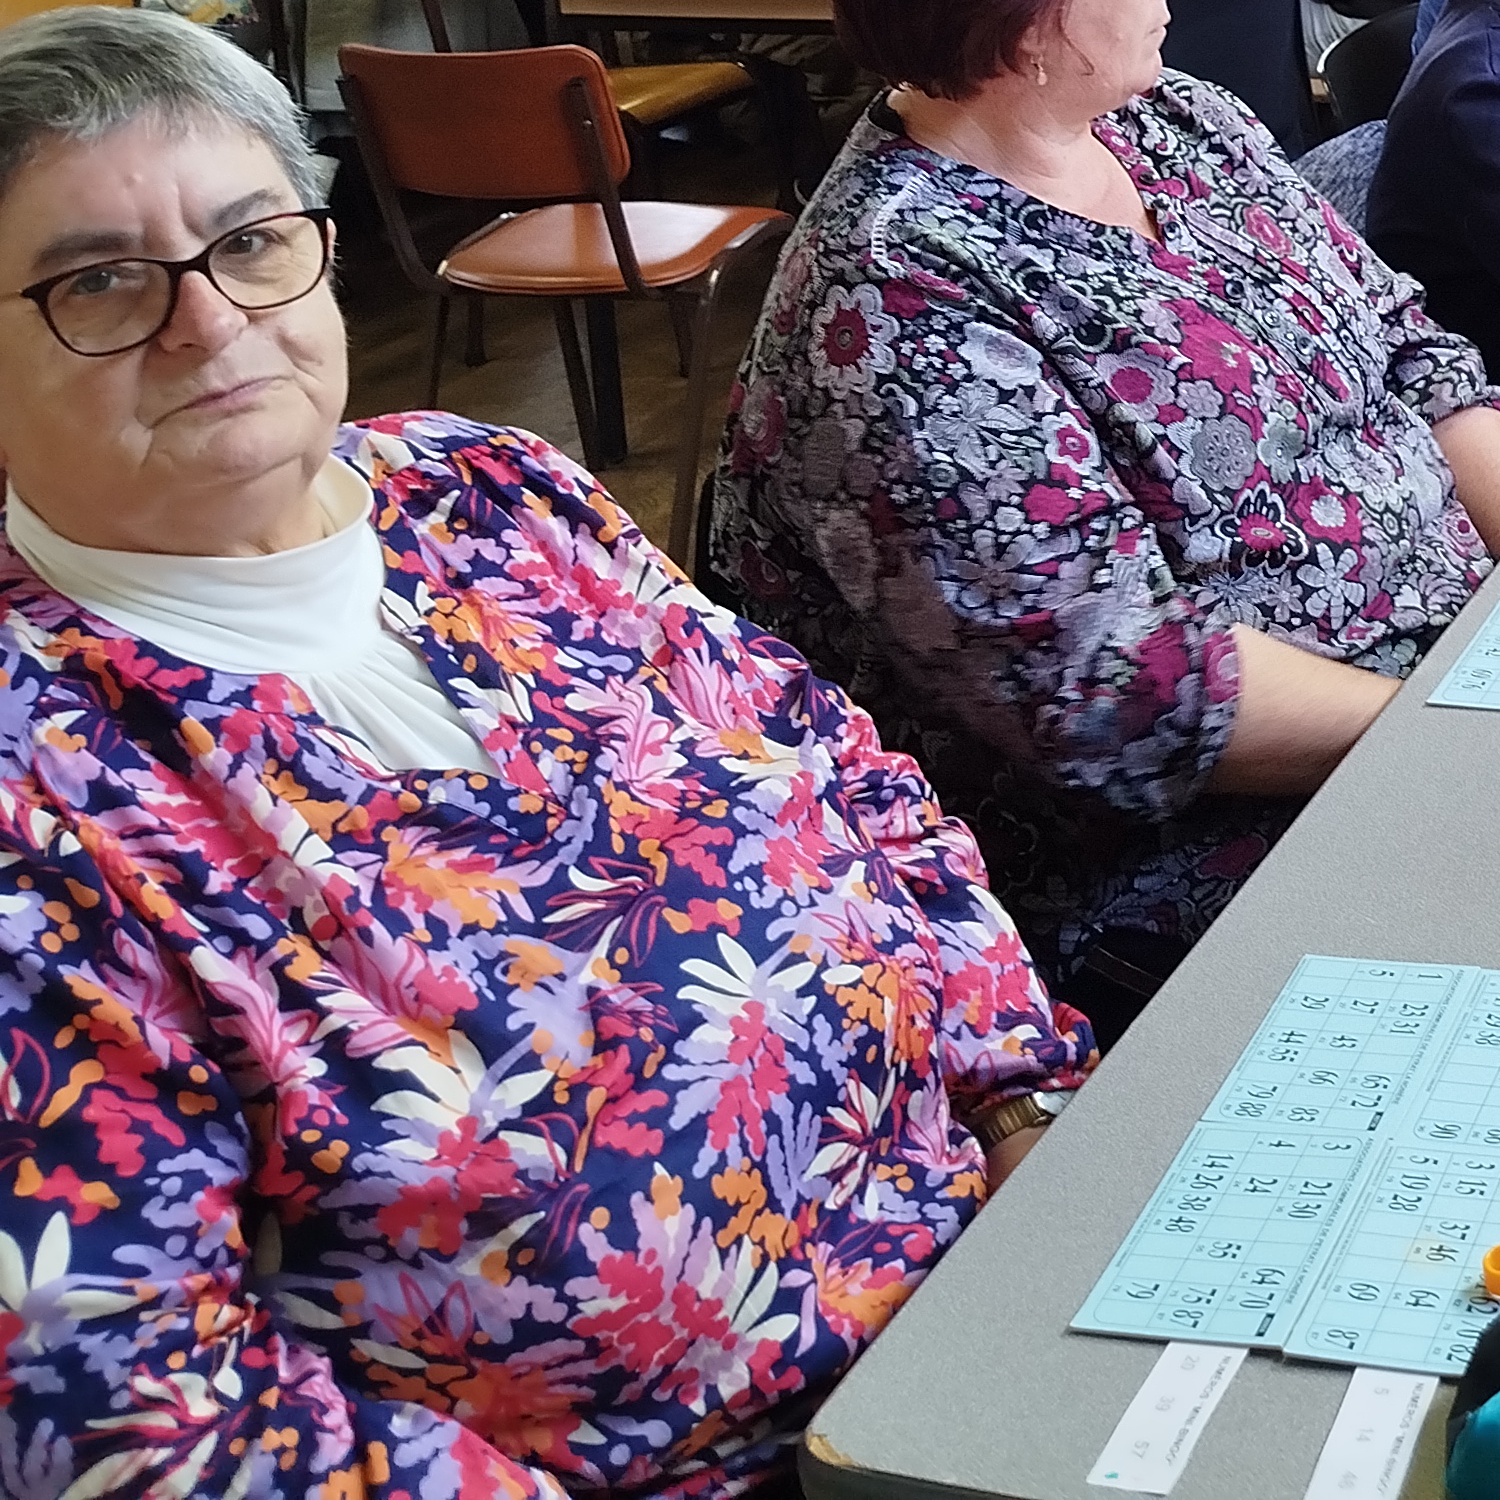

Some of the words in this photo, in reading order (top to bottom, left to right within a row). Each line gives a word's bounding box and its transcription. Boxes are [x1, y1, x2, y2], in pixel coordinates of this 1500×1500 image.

[1301, 995, 1330, 1010] 29
[1349, 999, 1380, 1013] 27
[1398, 1003, 1430, 1017] 23
[1388, 1022, 1421, 1035] 31
[1277, 1030, 1308, 1045] 44
[1328, 1034, 1359, 1049] 43
[1267, 1046, 1299, 1063] 55
[1308, 1070, 1340, 1086] 66
[1360, 1074, 1392, 1090] 65
[1246, 1083, 1278, 1099] 79
[1349, 1092, 1381, 1108] 72
[1233, 1101, 1268, 1118] 88
[1286, 1106, 1320, 1123] 83
[1428, 1123, 1462, 1140] 90
[1268, 1139, 1296, 1148] 4
[1322, 1138, 1351, 1152] 3
[1201, 1154, 1235, 1169] 14
[1409, 1155, 1439, 1166] 5
[1465, 1160, 1496, 1170] 3
[1189, 1172, 1225, 1190] 26
[1243, 1176, 1279, 1194] 24
[1297, 1180, 1333, 1197] 21
[1399, 1173, 1432, 1191] 19
[1454, 1179, 1488, 1196] 15
[1177, 1193, 1213, 1212] 38
[1287, 1201, 1323, 1219] 30
[1387, 1193, 1423, 1212] 28
[1164, 1215, 1198, 1233] 48
[1437, 1221, 1471, 1241] 37
[1207, 1241, 1242, 1260] 55
[1425, 1244, 1460, 1263] 46
[1250, 1268, 1286, 1286] 64
[1125, 1282, 1156, 1300] 79
[1181, 1287, 1218, 1304] 75
[1347, 1282, 1381, 1302] 69
[1404, 1289, 1441, 1309] 64
[1238, 1291, 1276, 1310] 70
[1466, 1296, 1500, 1314] 62
[1169, 1309, 1205, 1329] 87
[1324, 1328, 1360, 1351] 87
[1180, 1355, 1200, 1371] 20
[1374, 1387, 1390, 1396] 5
[1156, 1396, 1175, 1412] 39
[1356, 1428, 1375, 1442] 14
[1132, 1440, 1150, 1459] 57
